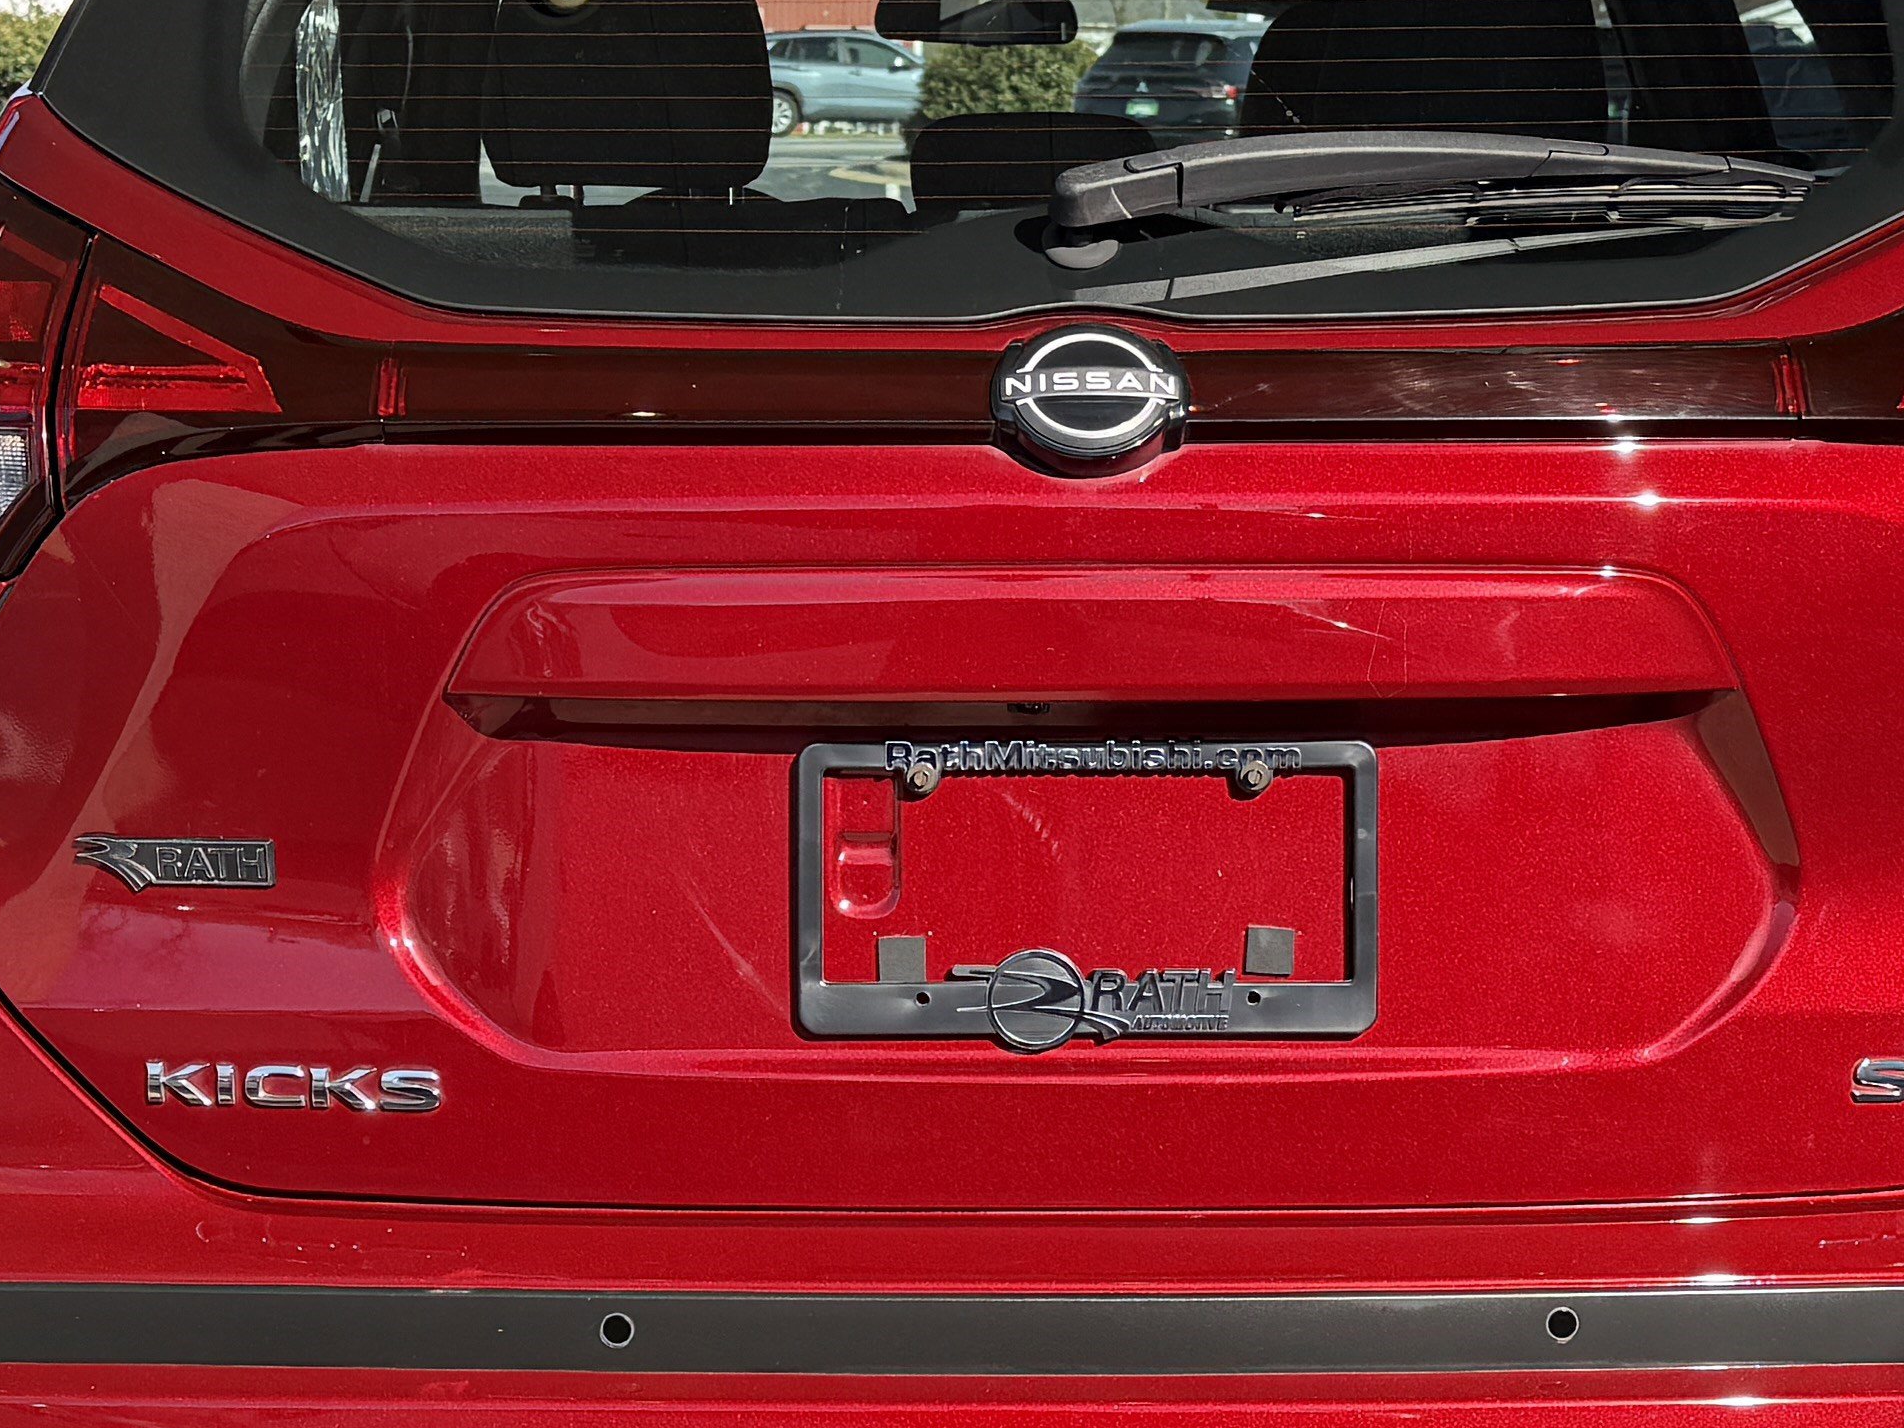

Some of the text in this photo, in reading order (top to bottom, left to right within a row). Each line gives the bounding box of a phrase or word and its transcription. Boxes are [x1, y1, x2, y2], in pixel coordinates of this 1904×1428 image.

[1005, 371, 1176, 396] NISSAN
[884, 739, 1302, 771] RathMitsubishi.com
[155, 846, 266, 880] RATH
[1092, 968, 1235, 1012] RATH
[145, 1059, 442, 1112] KICKS
